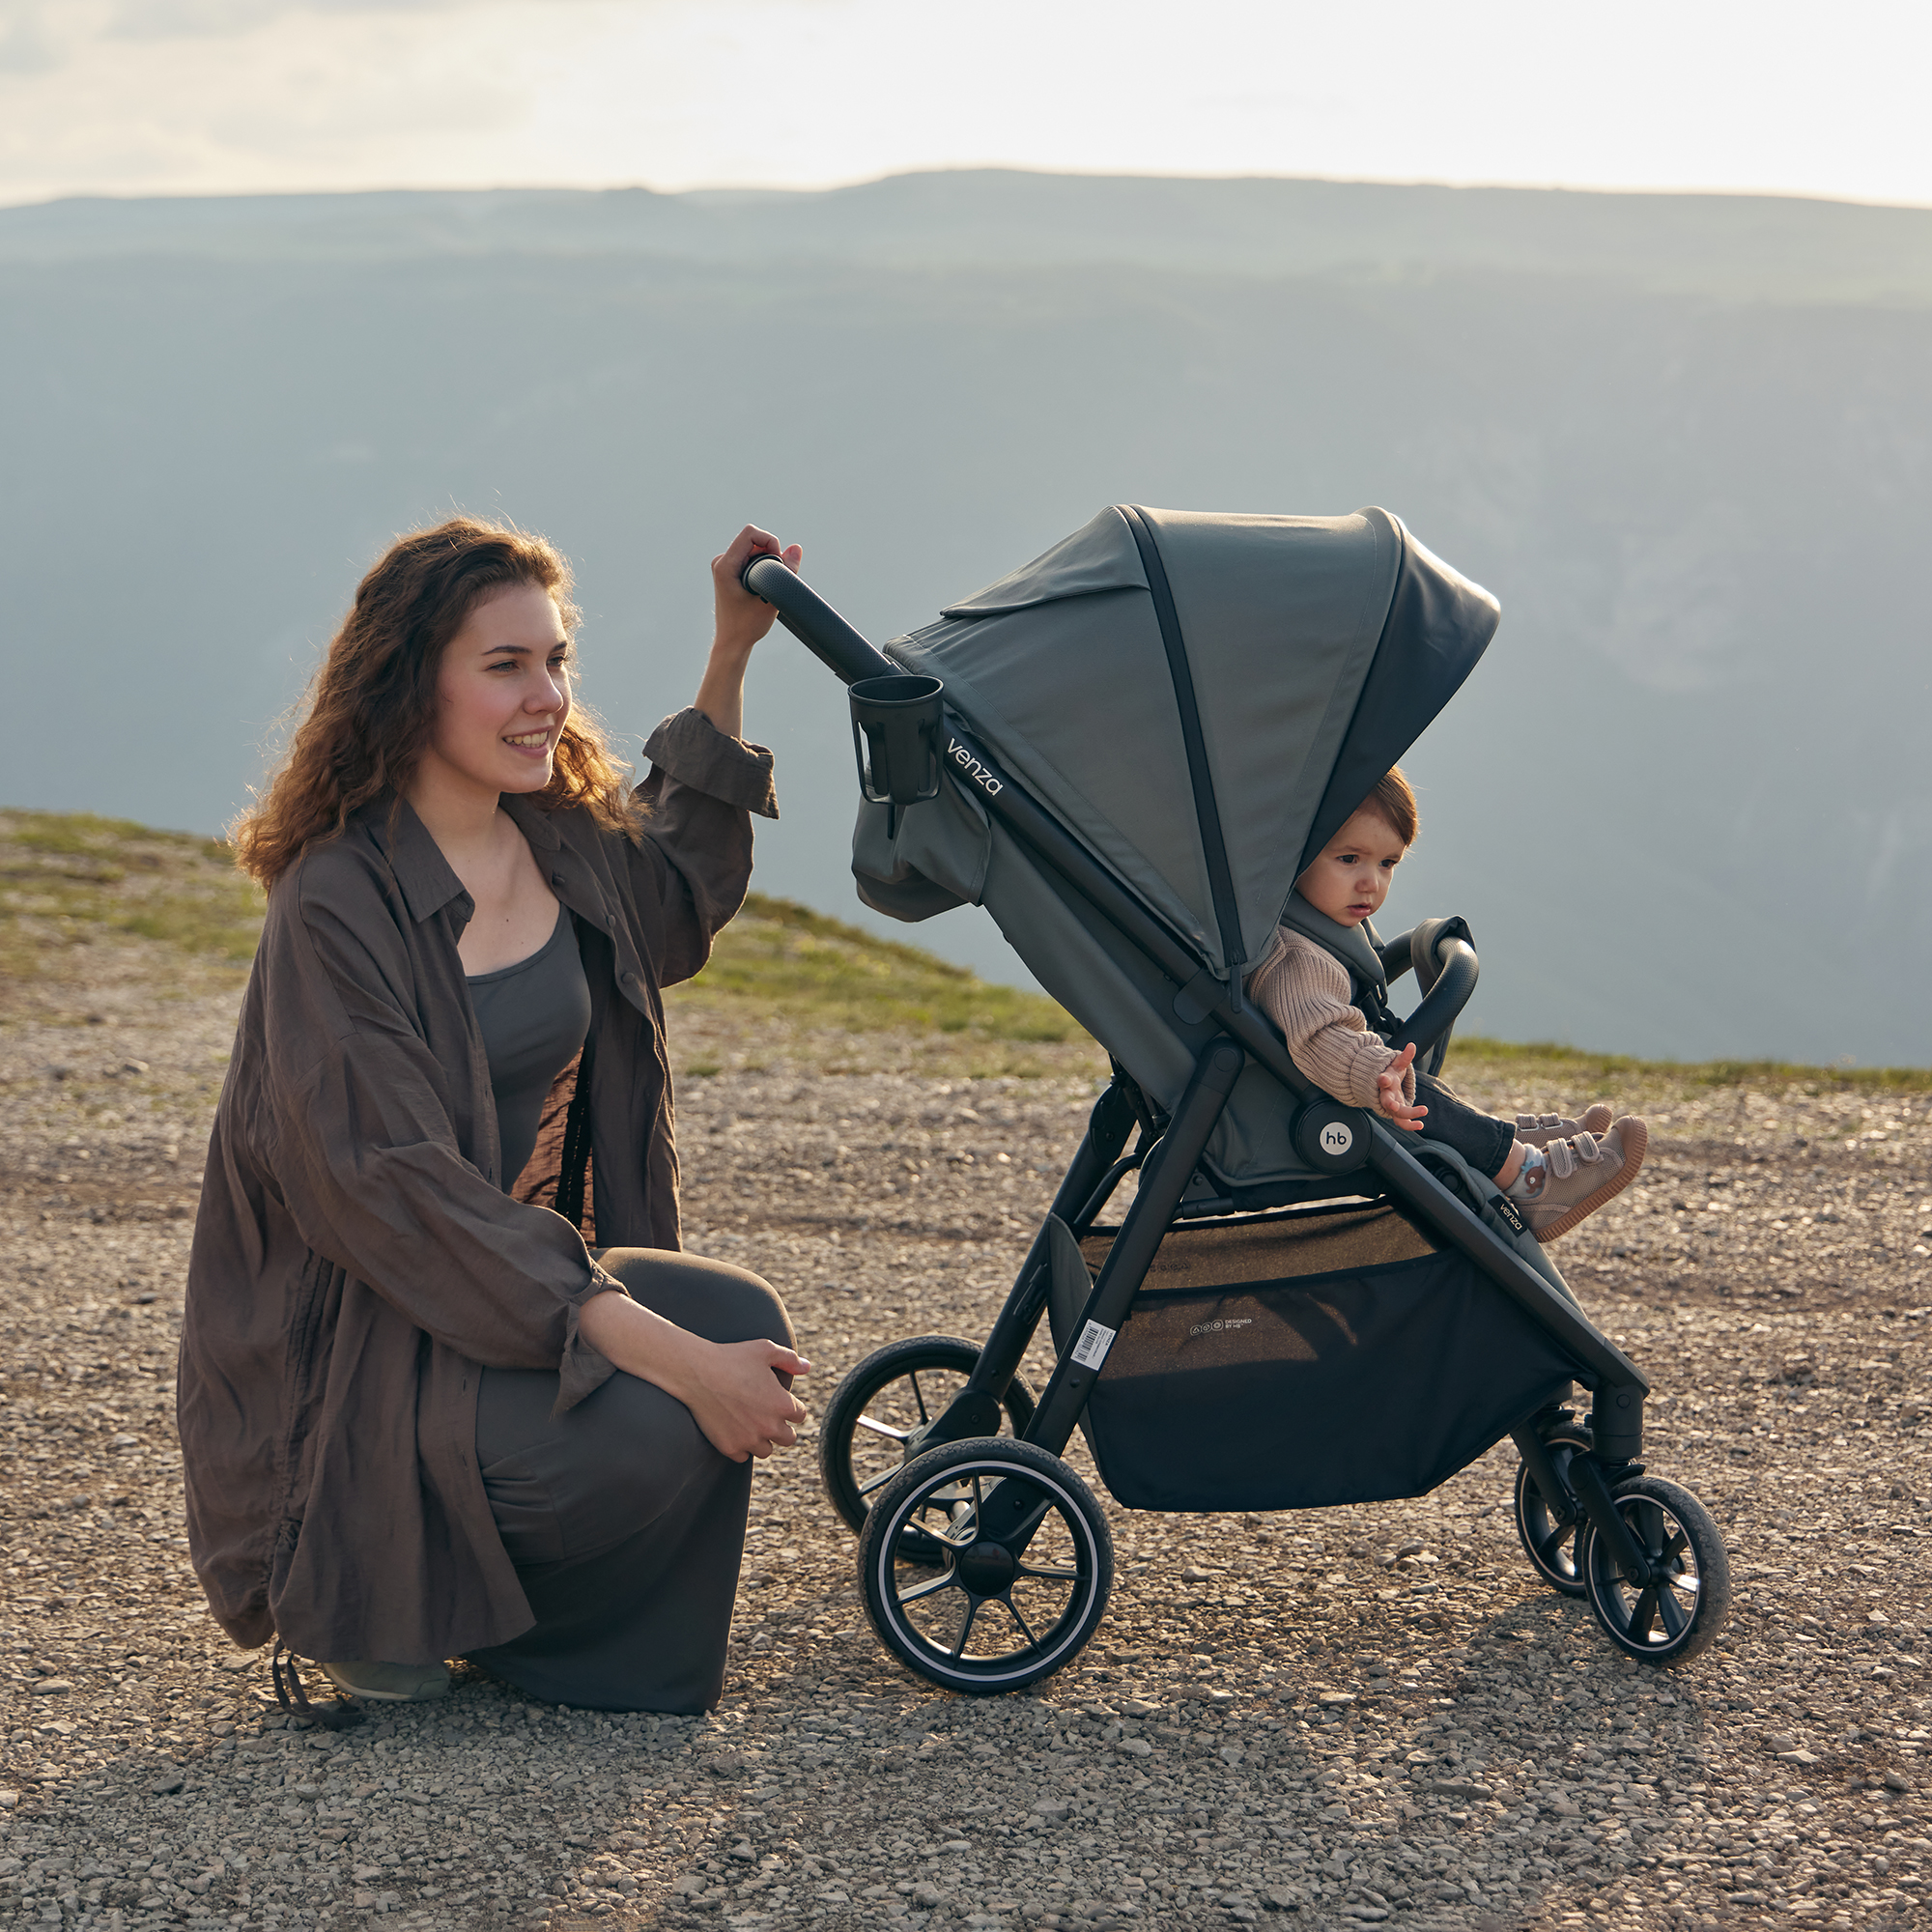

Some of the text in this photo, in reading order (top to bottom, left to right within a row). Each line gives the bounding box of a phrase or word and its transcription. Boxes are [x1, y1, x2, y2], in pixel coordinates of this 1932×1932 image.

[947, 737, 1004, 797] venza
[1325, 1131, 1348, 1146] hb
[1499, 1203, 1523, 1231] venza
